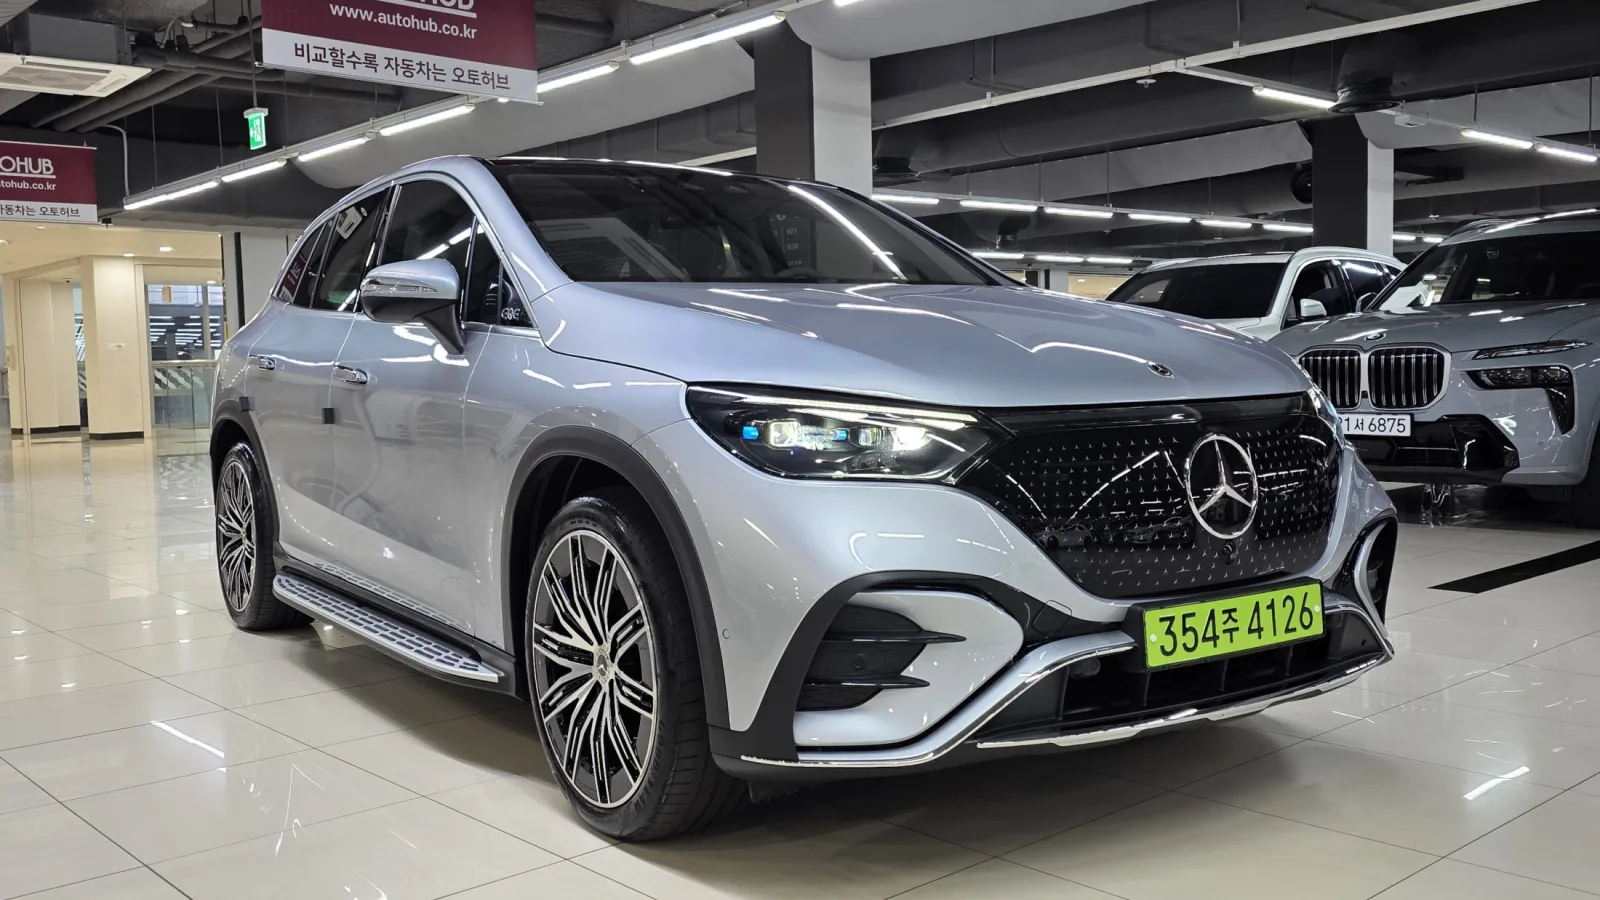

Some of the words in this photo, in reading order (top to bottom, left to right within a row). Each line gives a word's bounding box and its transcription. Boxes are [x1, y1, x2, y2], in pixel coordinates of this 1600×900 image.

[329, 4, 477, 39] www.autohub.co.kr
[294, 43, 379, 73] 비교할수록
[384, 56, 447, 83] 자동차는
[452, 67, 511, 90] 오토허브
[0, 180, 56, 191] tohub.co.kr
[39, 206, 80, 217] 오토허브
[1339, 417, 1364, 431] 1서
[1368, 417, 1406, 433] 6875
[1159, 607, 1239, 656] 354주
[1247, 592, 1313, 640] 4126
